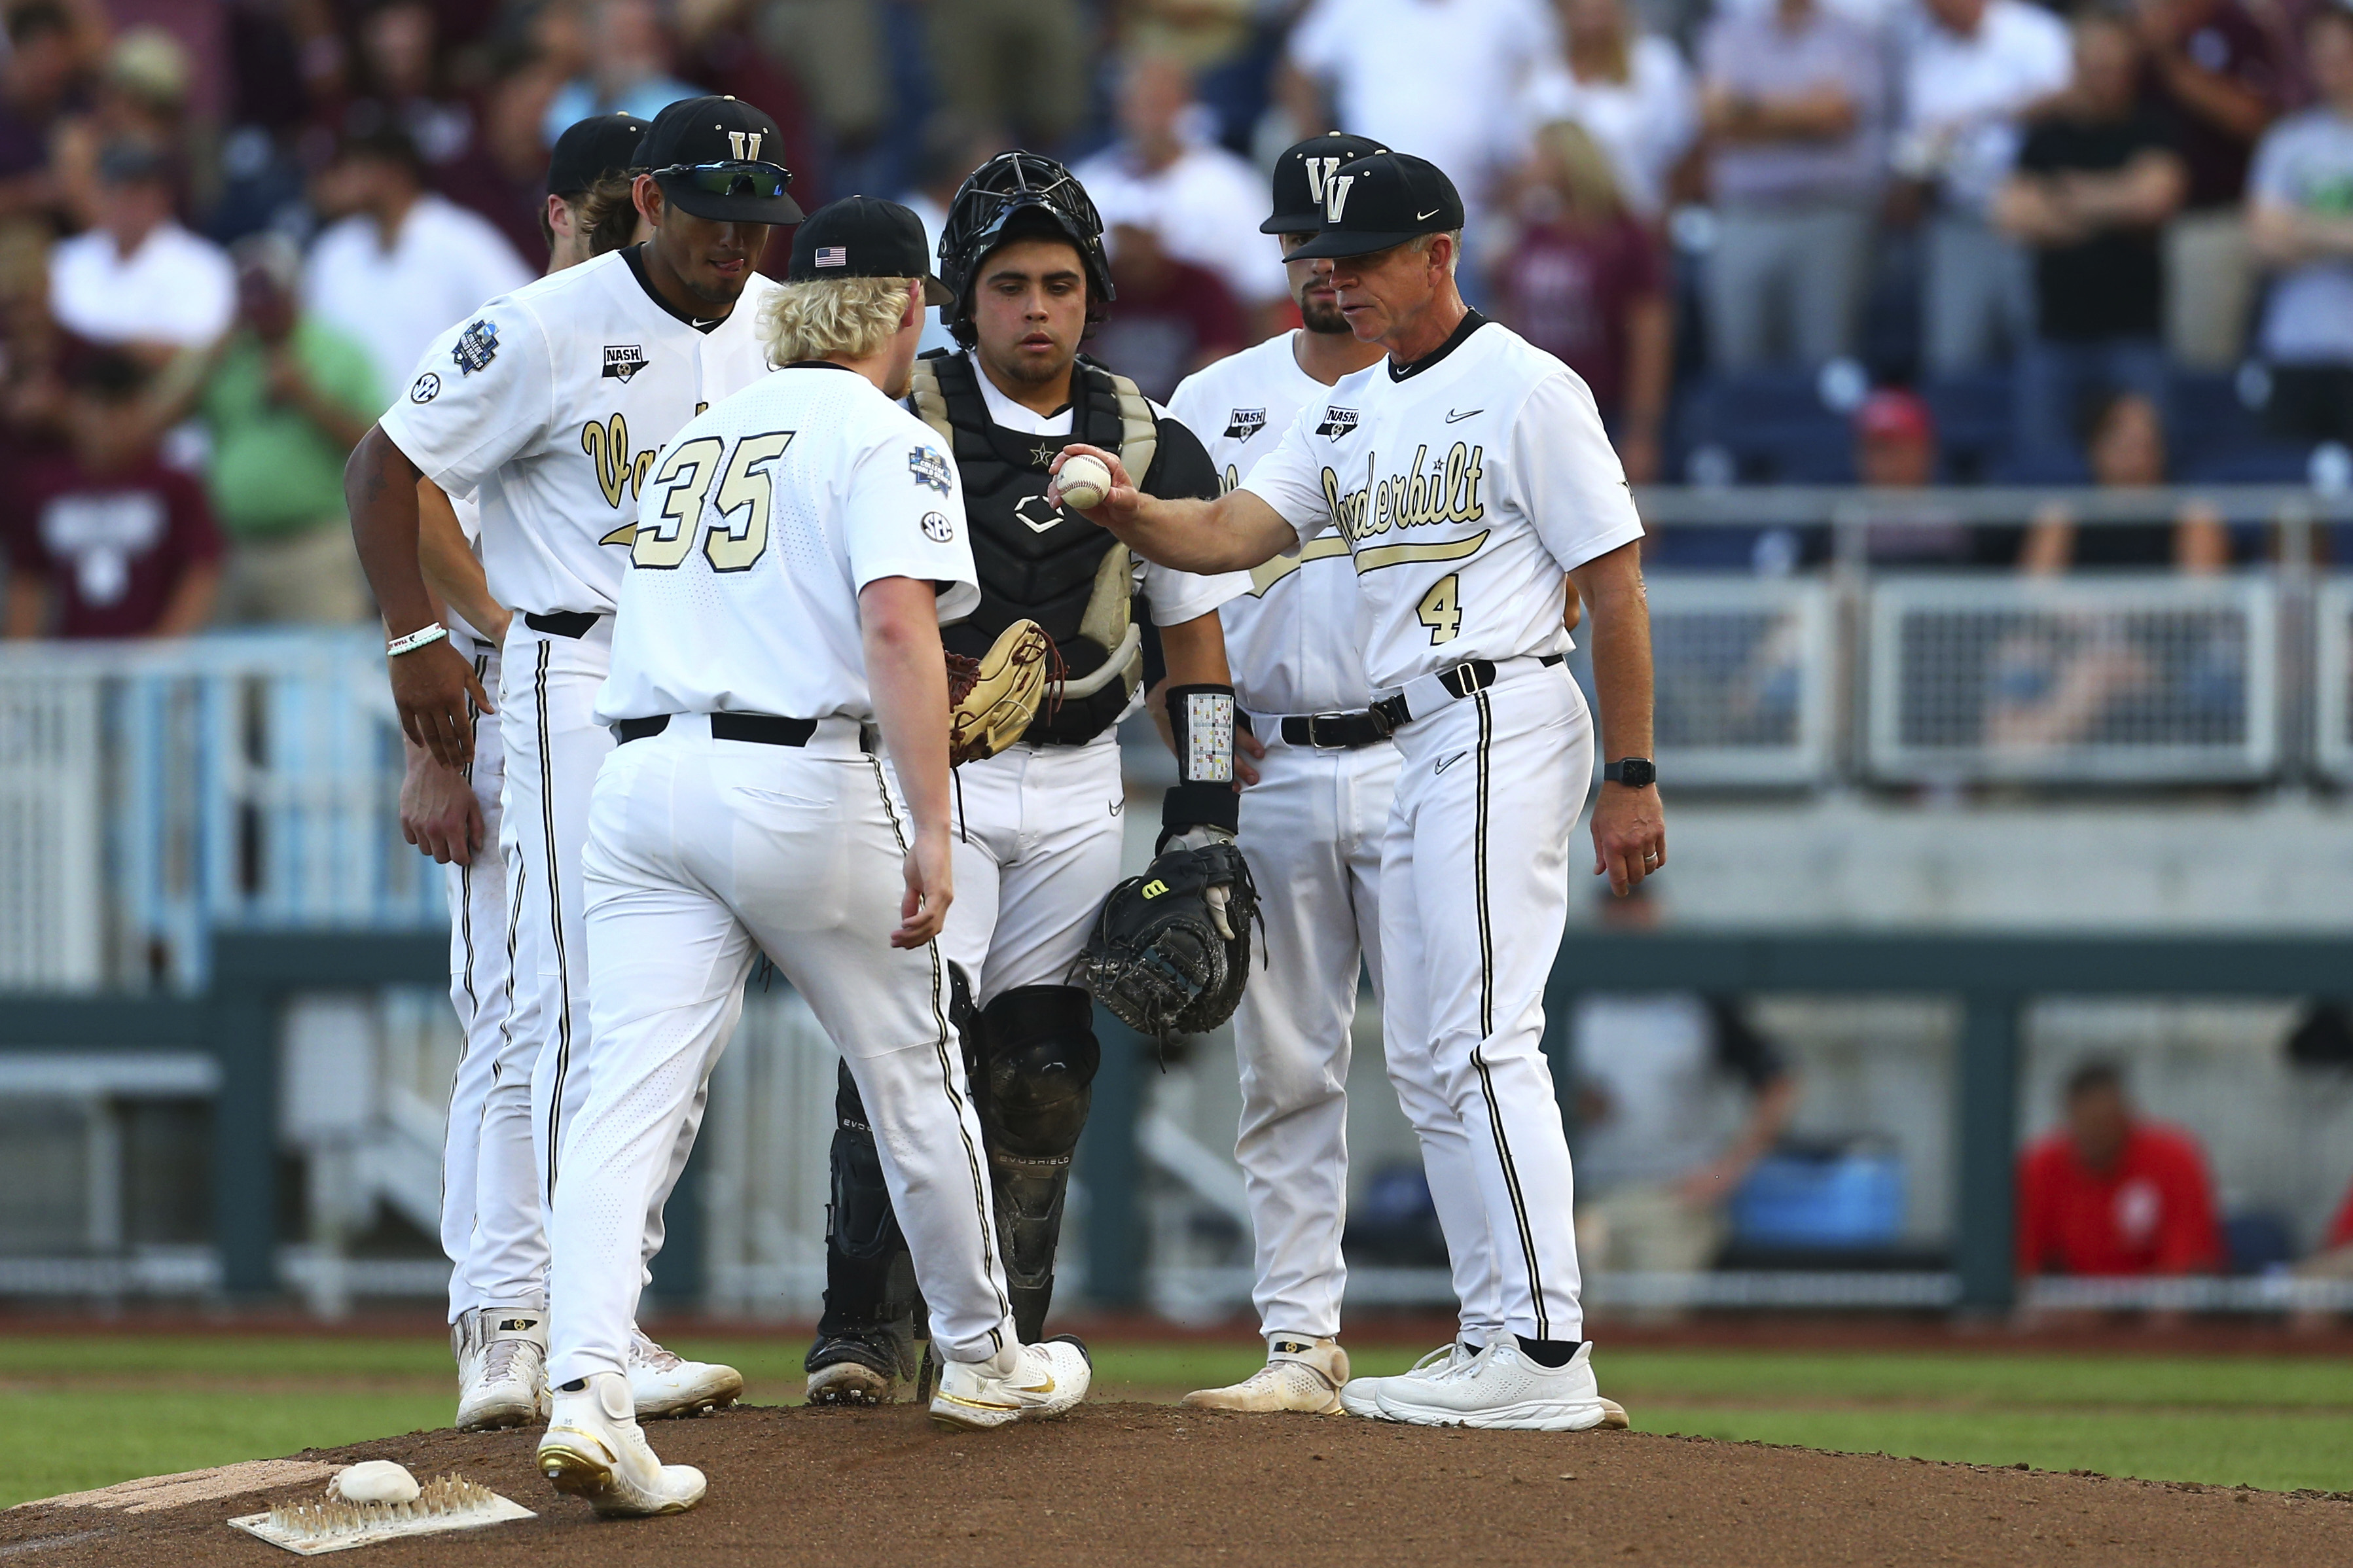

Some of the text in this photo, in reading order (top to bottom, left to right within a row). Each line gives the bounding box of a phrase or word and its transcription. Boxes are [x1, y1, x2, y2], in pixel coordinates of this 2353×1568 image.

[728, 131, 762, 161] V
[1306, 157, 1340, 204] V
[1327, 175, 1354, 223] V
[607, 348, 641, 362] NASH
[412, 374, 439, 402] SEC
[1234, 411, 1264, 424] NASH
[1326, 409, 1357, 423] NASH
[920, 459, 944, 475] COLLEGE
[630, 430, 797, 574] 35
[923, 512, 953, 541] SEC
[1415, 573, 1463, 646] 4
